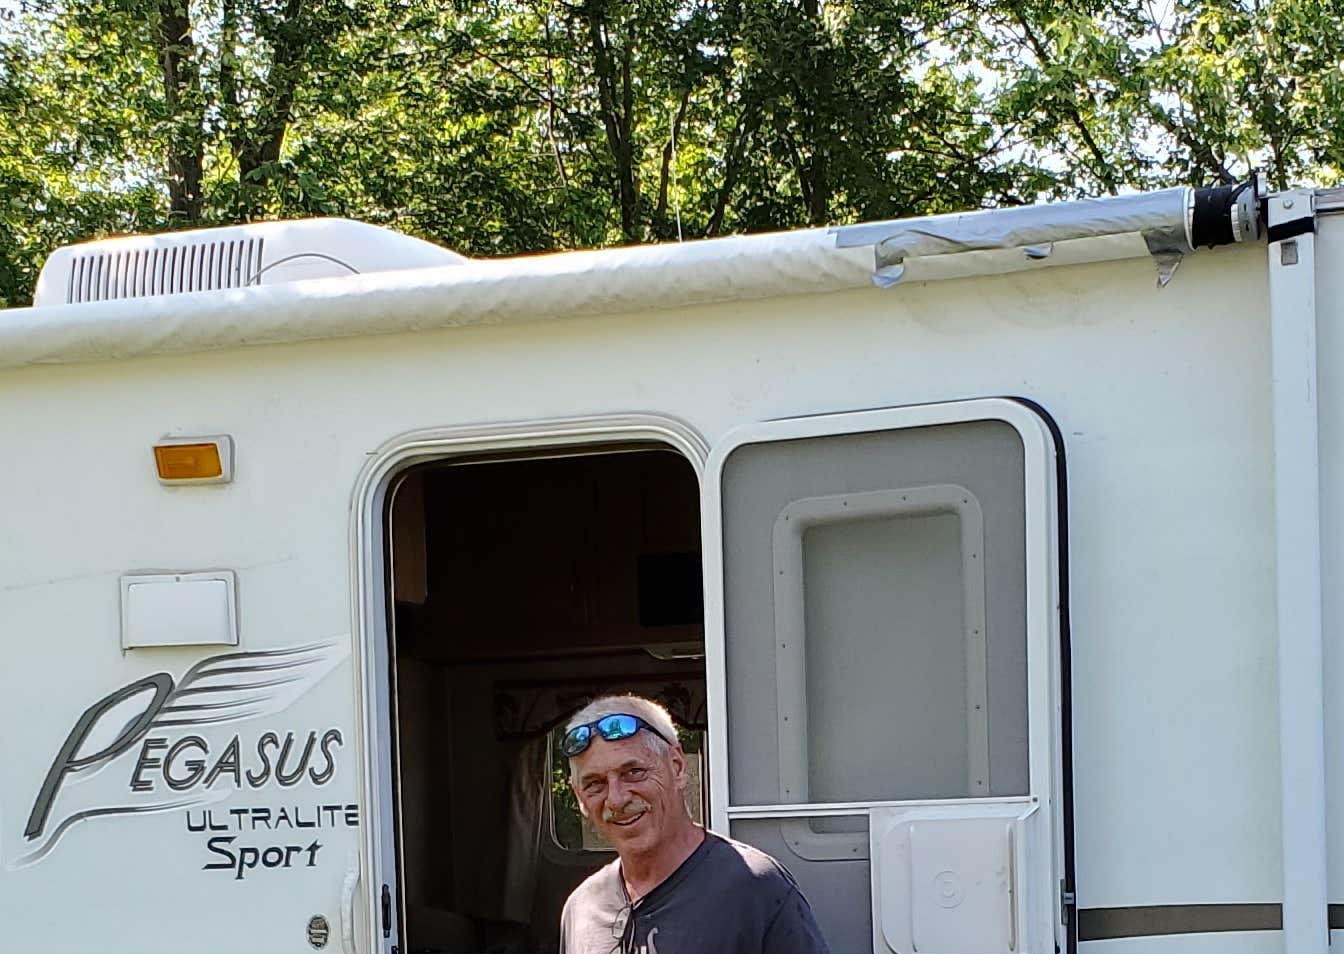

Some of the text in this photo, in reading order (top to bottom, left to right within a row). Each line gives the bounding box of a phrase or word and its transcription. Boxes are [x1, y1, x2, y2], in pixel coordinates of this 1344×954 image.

[24, 672, 343, 839] PEGASUS
[186, 804, 359, 832] ULTRALITE
[202, 836, 323, 879] Sport
